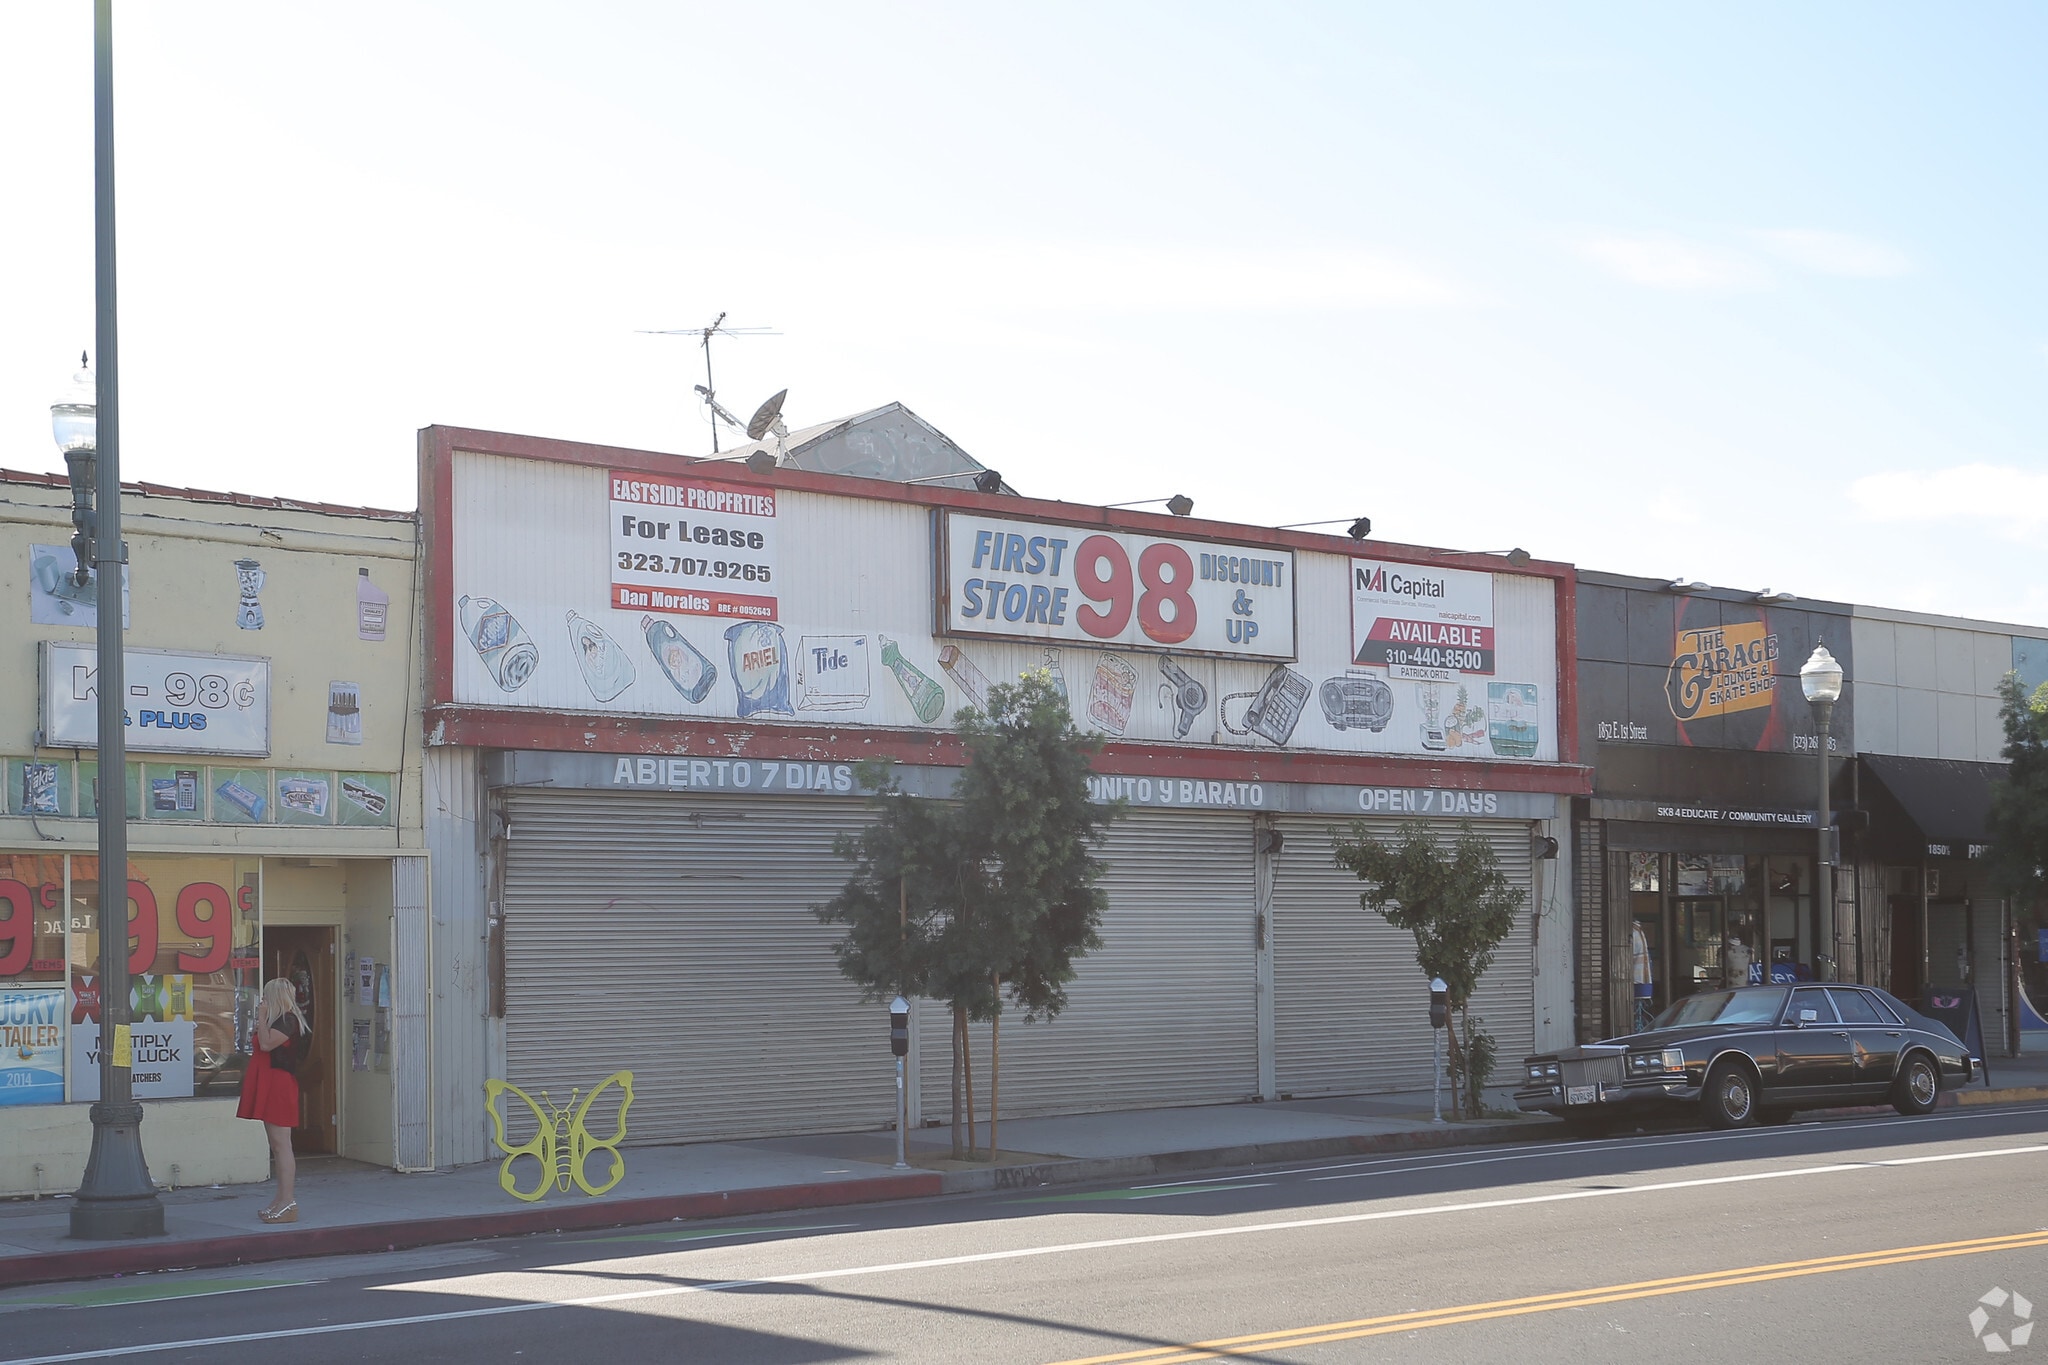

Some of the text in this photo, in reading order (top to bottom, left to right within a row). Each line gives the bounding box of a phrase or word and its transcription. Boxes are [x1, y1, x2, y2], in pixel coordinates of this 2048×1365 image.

[613, 479, 684, 507] EASTSIDE
[622, 515, 764, 550] For Lease
[971, 530, 1068, 576] FIRST
[617, 552, 771, 583] 323.707.9265
[1200, 552, 1284, 588] DISCOUNT
[1074, 534, 1198, 644] 98
[1356, 564, 1445, 600] NAI Capital
[620, 588, 648, 606] Dan
[651, 592, 710, 611] Morales
[718, 603, 731, 613] BRE
[961, 578, 1069, 626] STORE
[1231, 589, 1254, 616] &
[1438, 611, 1482, 622] naicapital.com
[1225, 618, 1259, 645] UP
[1389, 621, 1482, 648] AVAILABLE
[1682, 629, 1726, 654] THE
[742, 646, 779, 672] ARIEL
[811, 647, 848, 674] Tide
[1386, 646, 1482, 670] 310-440-8500
[1400, 667, 1450, 680] PATRICK ORTIZ
[1664, 634, 1779, 721] GARAGE
[1716, 664, 1770, 689] LOUNGE &
[164, 672, 255, 711] 98¢
[1709, 676, 1777, 706] SKATE SHOP
[139, 709, 208, 731] PLUS
[1613, 721, 1620, 739] E.
[1630, 721, 1648, 740] Street
[1793, 733, 1808, 751] (323)
[613, 757, 852, 791] ABIERTO 7 DIAS
[1086, 775, 1151, 803] ONITO
[1179, 780, 1263, 806] BARATO
[1359, 788, 1497, 814] OPEN 7 DAYS
[1657, 807, 1812, 824] SK8 4 EDUCATE / COMMUNITY GALLERY
[34, 960, 63, 969] ITEMS
[0, 994, 61, 1026] UCKY
[0, 1025, 59, 1048] TAILER
[138, 1048, 181, 1063] LUCK
[6, 1072, 33, 1087] 2014
